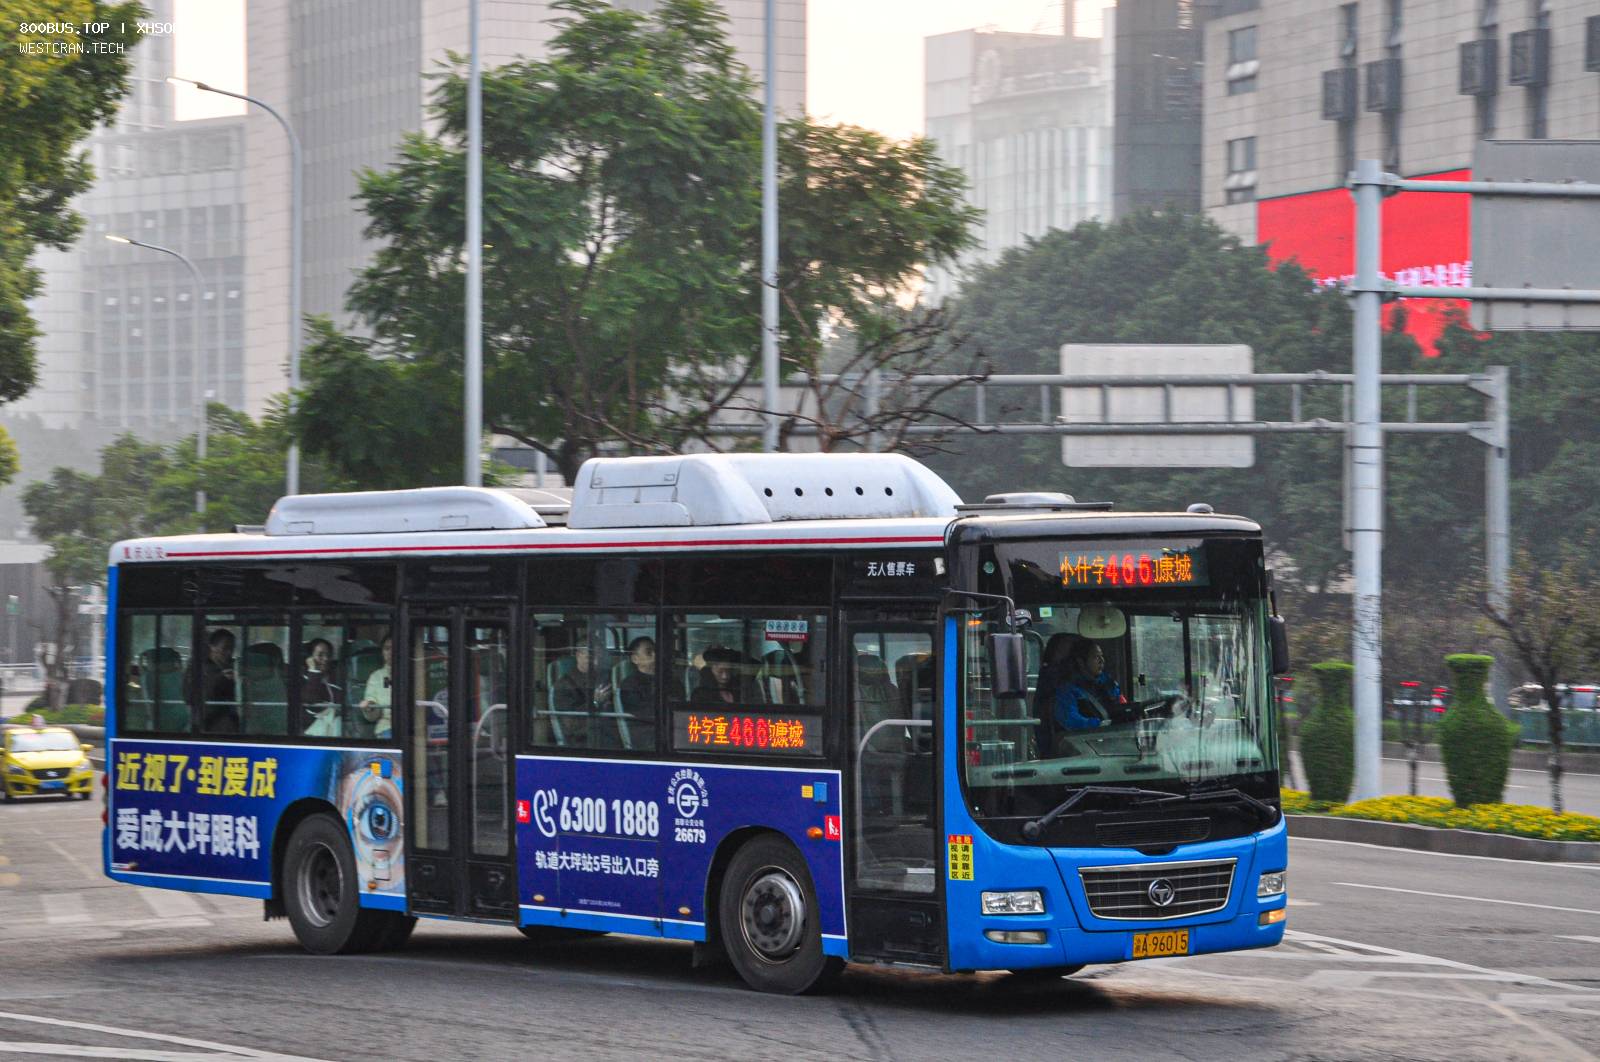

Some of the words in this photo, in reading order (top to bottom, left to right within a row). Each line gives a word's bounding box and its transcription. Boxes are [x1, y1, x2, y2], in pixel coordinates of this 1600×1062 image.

[867, 561, 915, 577] 无人售票车
[1105, 553, 1153, 585] 466
[729, 715, 769, 748] 466
[559, 796, 607, 833] 6300
[611, 799, 660, 838] 1888
[116, 807, 261, 860] 爱成大坪眼科
[674, 828, 707, 844] 26679
[535, 850, 660, 878] 轨道大坪站5号出入口旁
